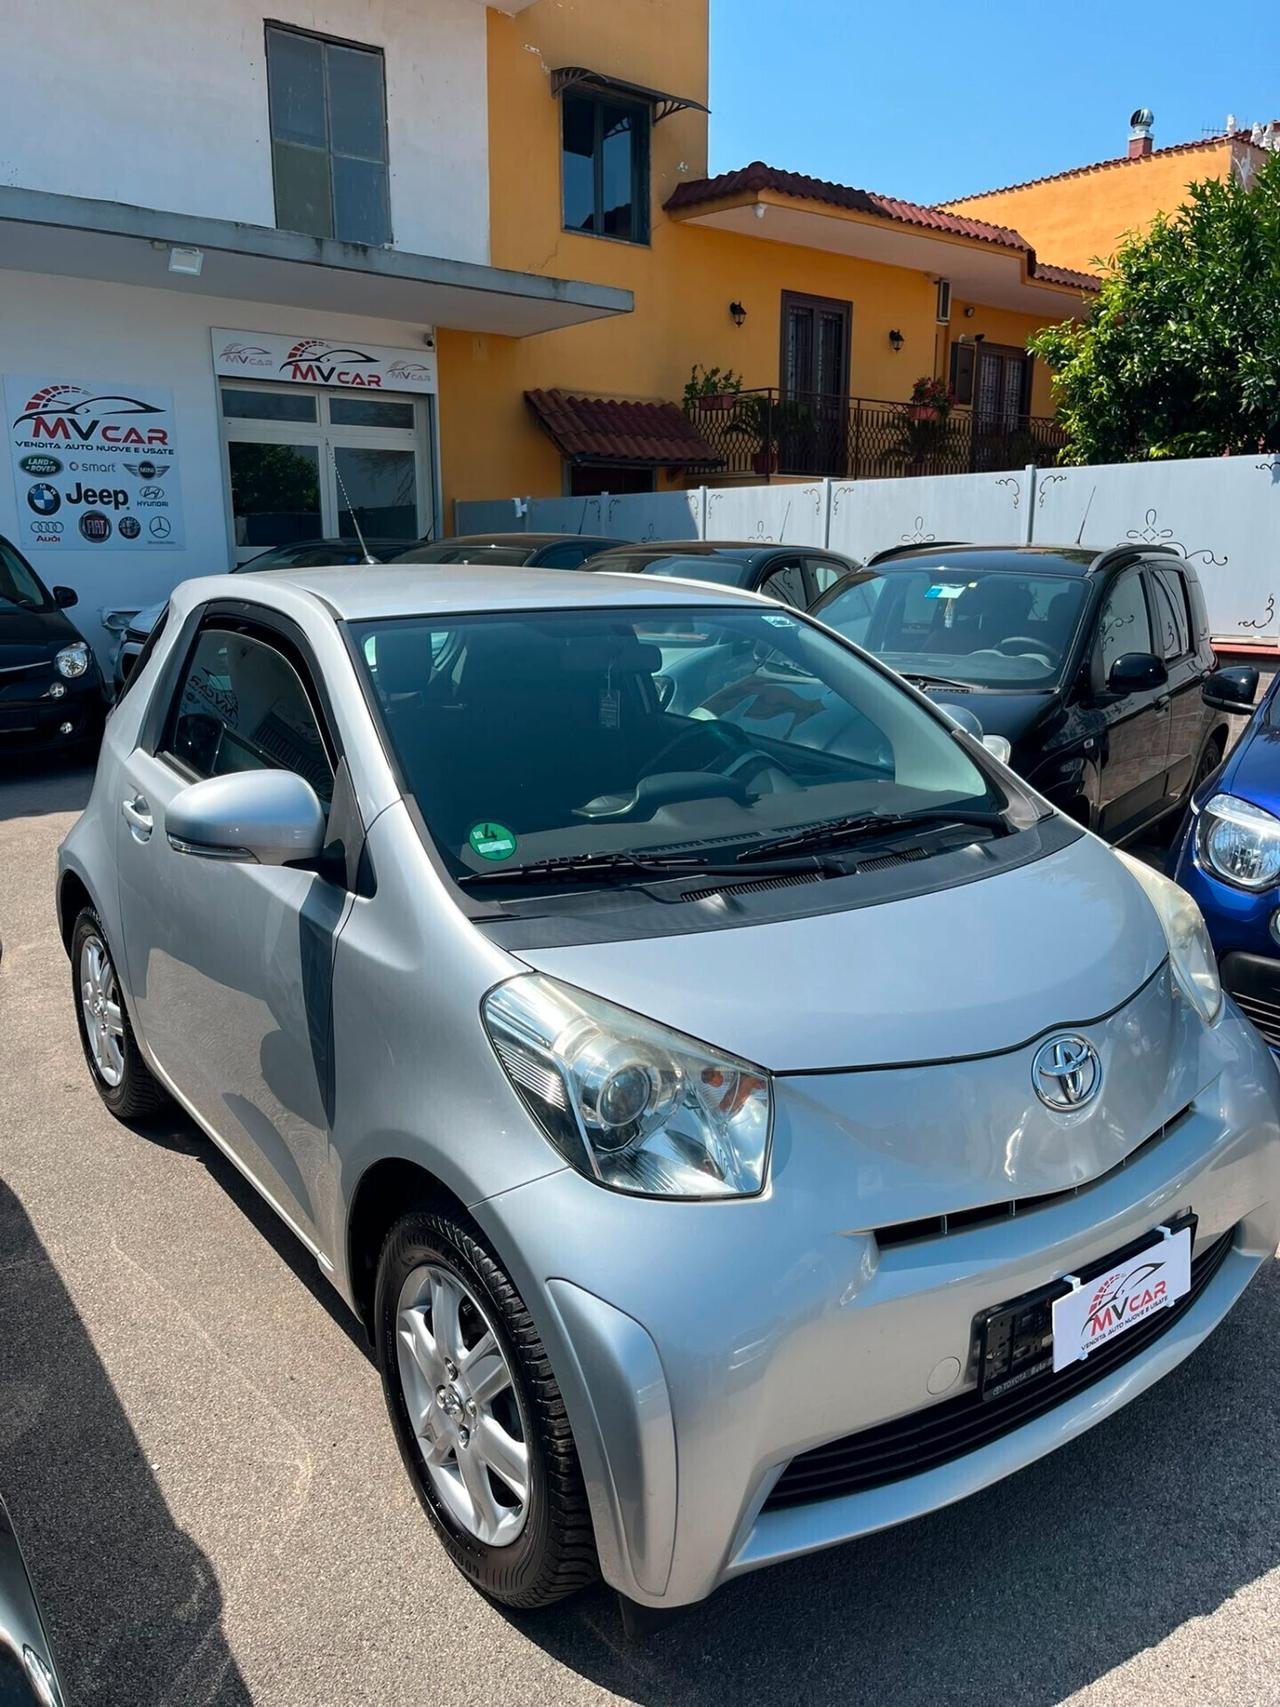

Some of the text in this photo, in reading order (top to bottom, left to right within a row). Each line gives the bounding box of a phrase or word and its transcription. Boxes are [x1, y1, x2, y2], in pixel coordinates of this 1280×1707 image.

[291, 363, 382, 387] MVCAR
[32, 415, 168, 446] MVCAR
[15, 440, 62, 450] VENDITA
[64, 443, 94, 451] AUTO
[96, 445, 132, 454] NUOVE
[142, 447, 175, 456] USATE
[28, 458, 50, 466] LAND
[30, 465, 57, 473] ROVER
[82, 461, 116, 473] smart
[65, 482, 129, 510] Jeep
[136, 500, 169, 508] HYUNDAI
[86, 518, 105, 535] FIAT
[36, 534, 61, 543] Audi
[484, 824, 497, 841] 4
[1090, 1280, 1167, 1337] MVCAR
[1081, 1333, 1106, 1351] VENDITA
[1107, 1323, 1124, 1336] AUTO
[1125, 1311, 1145, 1325] NUOVE
[1150, 1295, 1168, 1310] USATE
